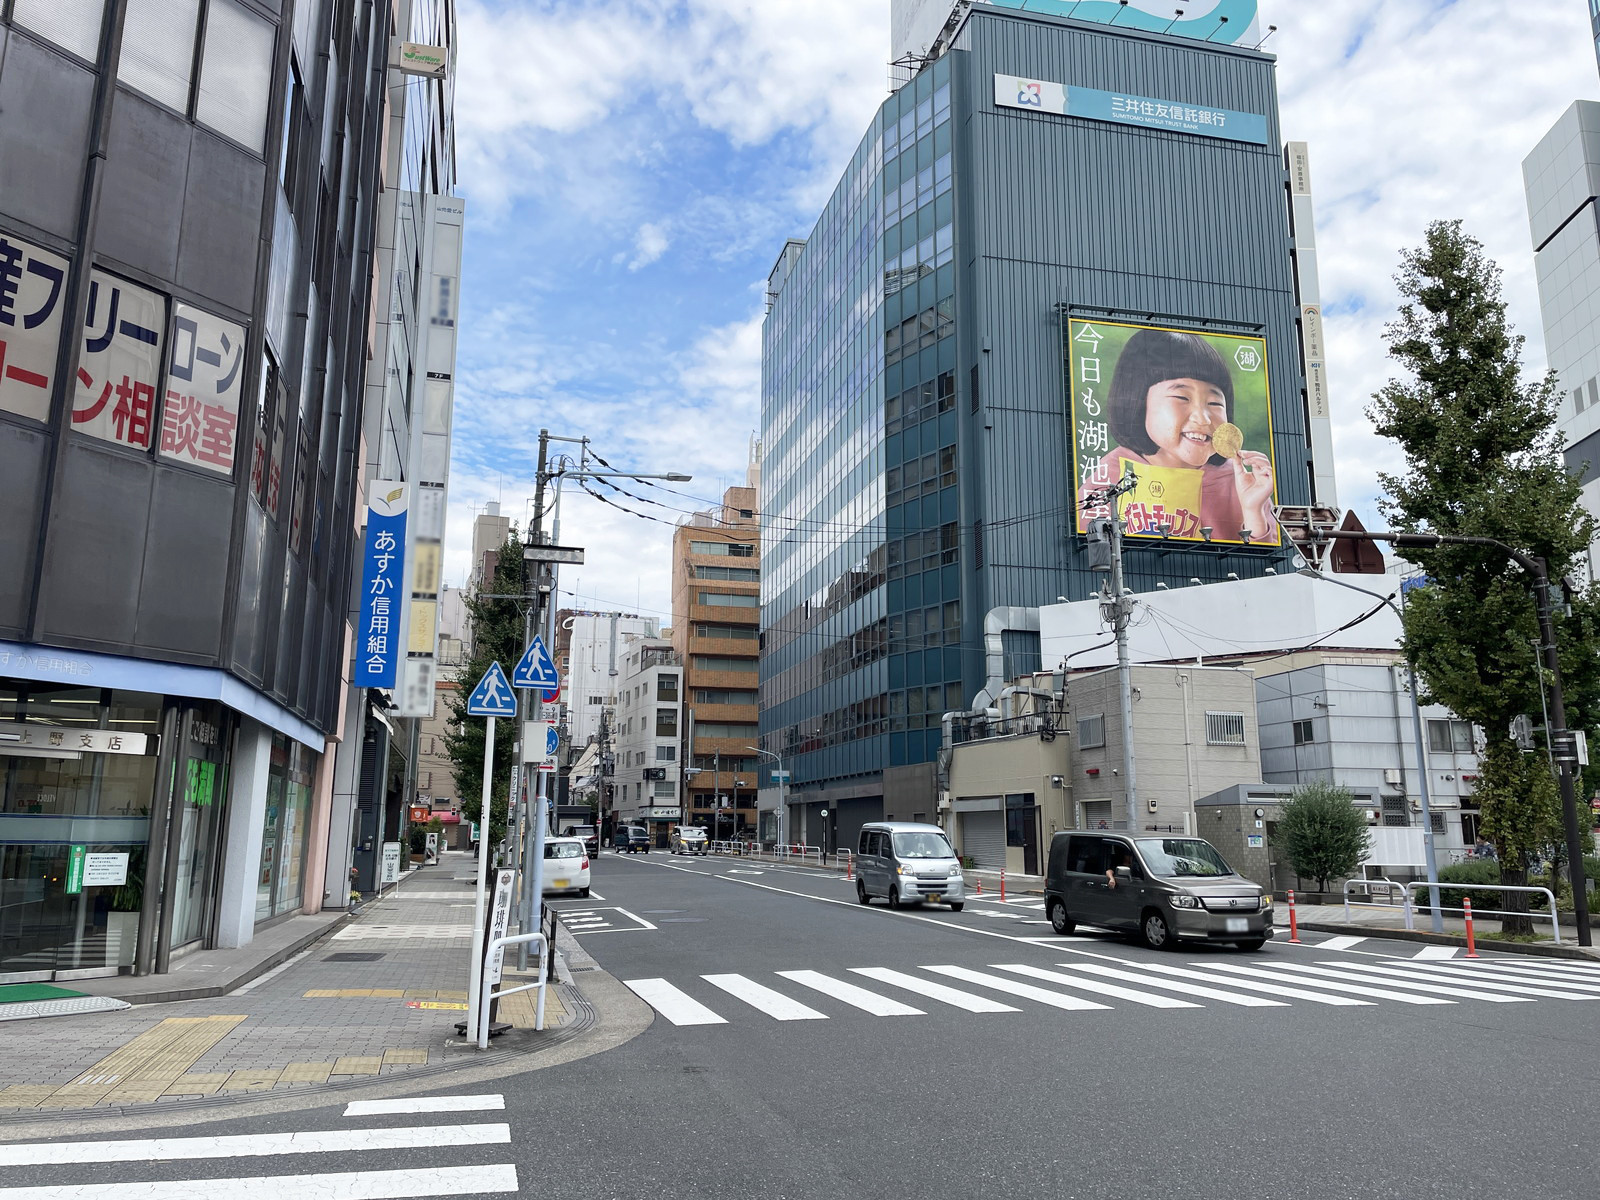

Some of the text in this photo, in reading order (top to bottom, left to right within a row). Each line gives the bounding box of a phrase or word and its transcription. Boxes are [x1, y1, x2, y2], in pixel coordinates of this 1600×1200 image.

[1111, 96, 1226, 128] 三井住友信託銀行
[1112, 112, 1198, 131] SUMITOMO MITSUI TRUST BANK
[1309, 316, 1318, 357] レインボー薬品
[1238, 350, 1256, 367] 湖
[1073, 323, 1112, 522] 今日も湖池屋
[1124, 503, 1200, 538] ポテトチップス
[365, 529, 396, 675] あすか信用組合
[18, 729, 123, 751] 上野支店
